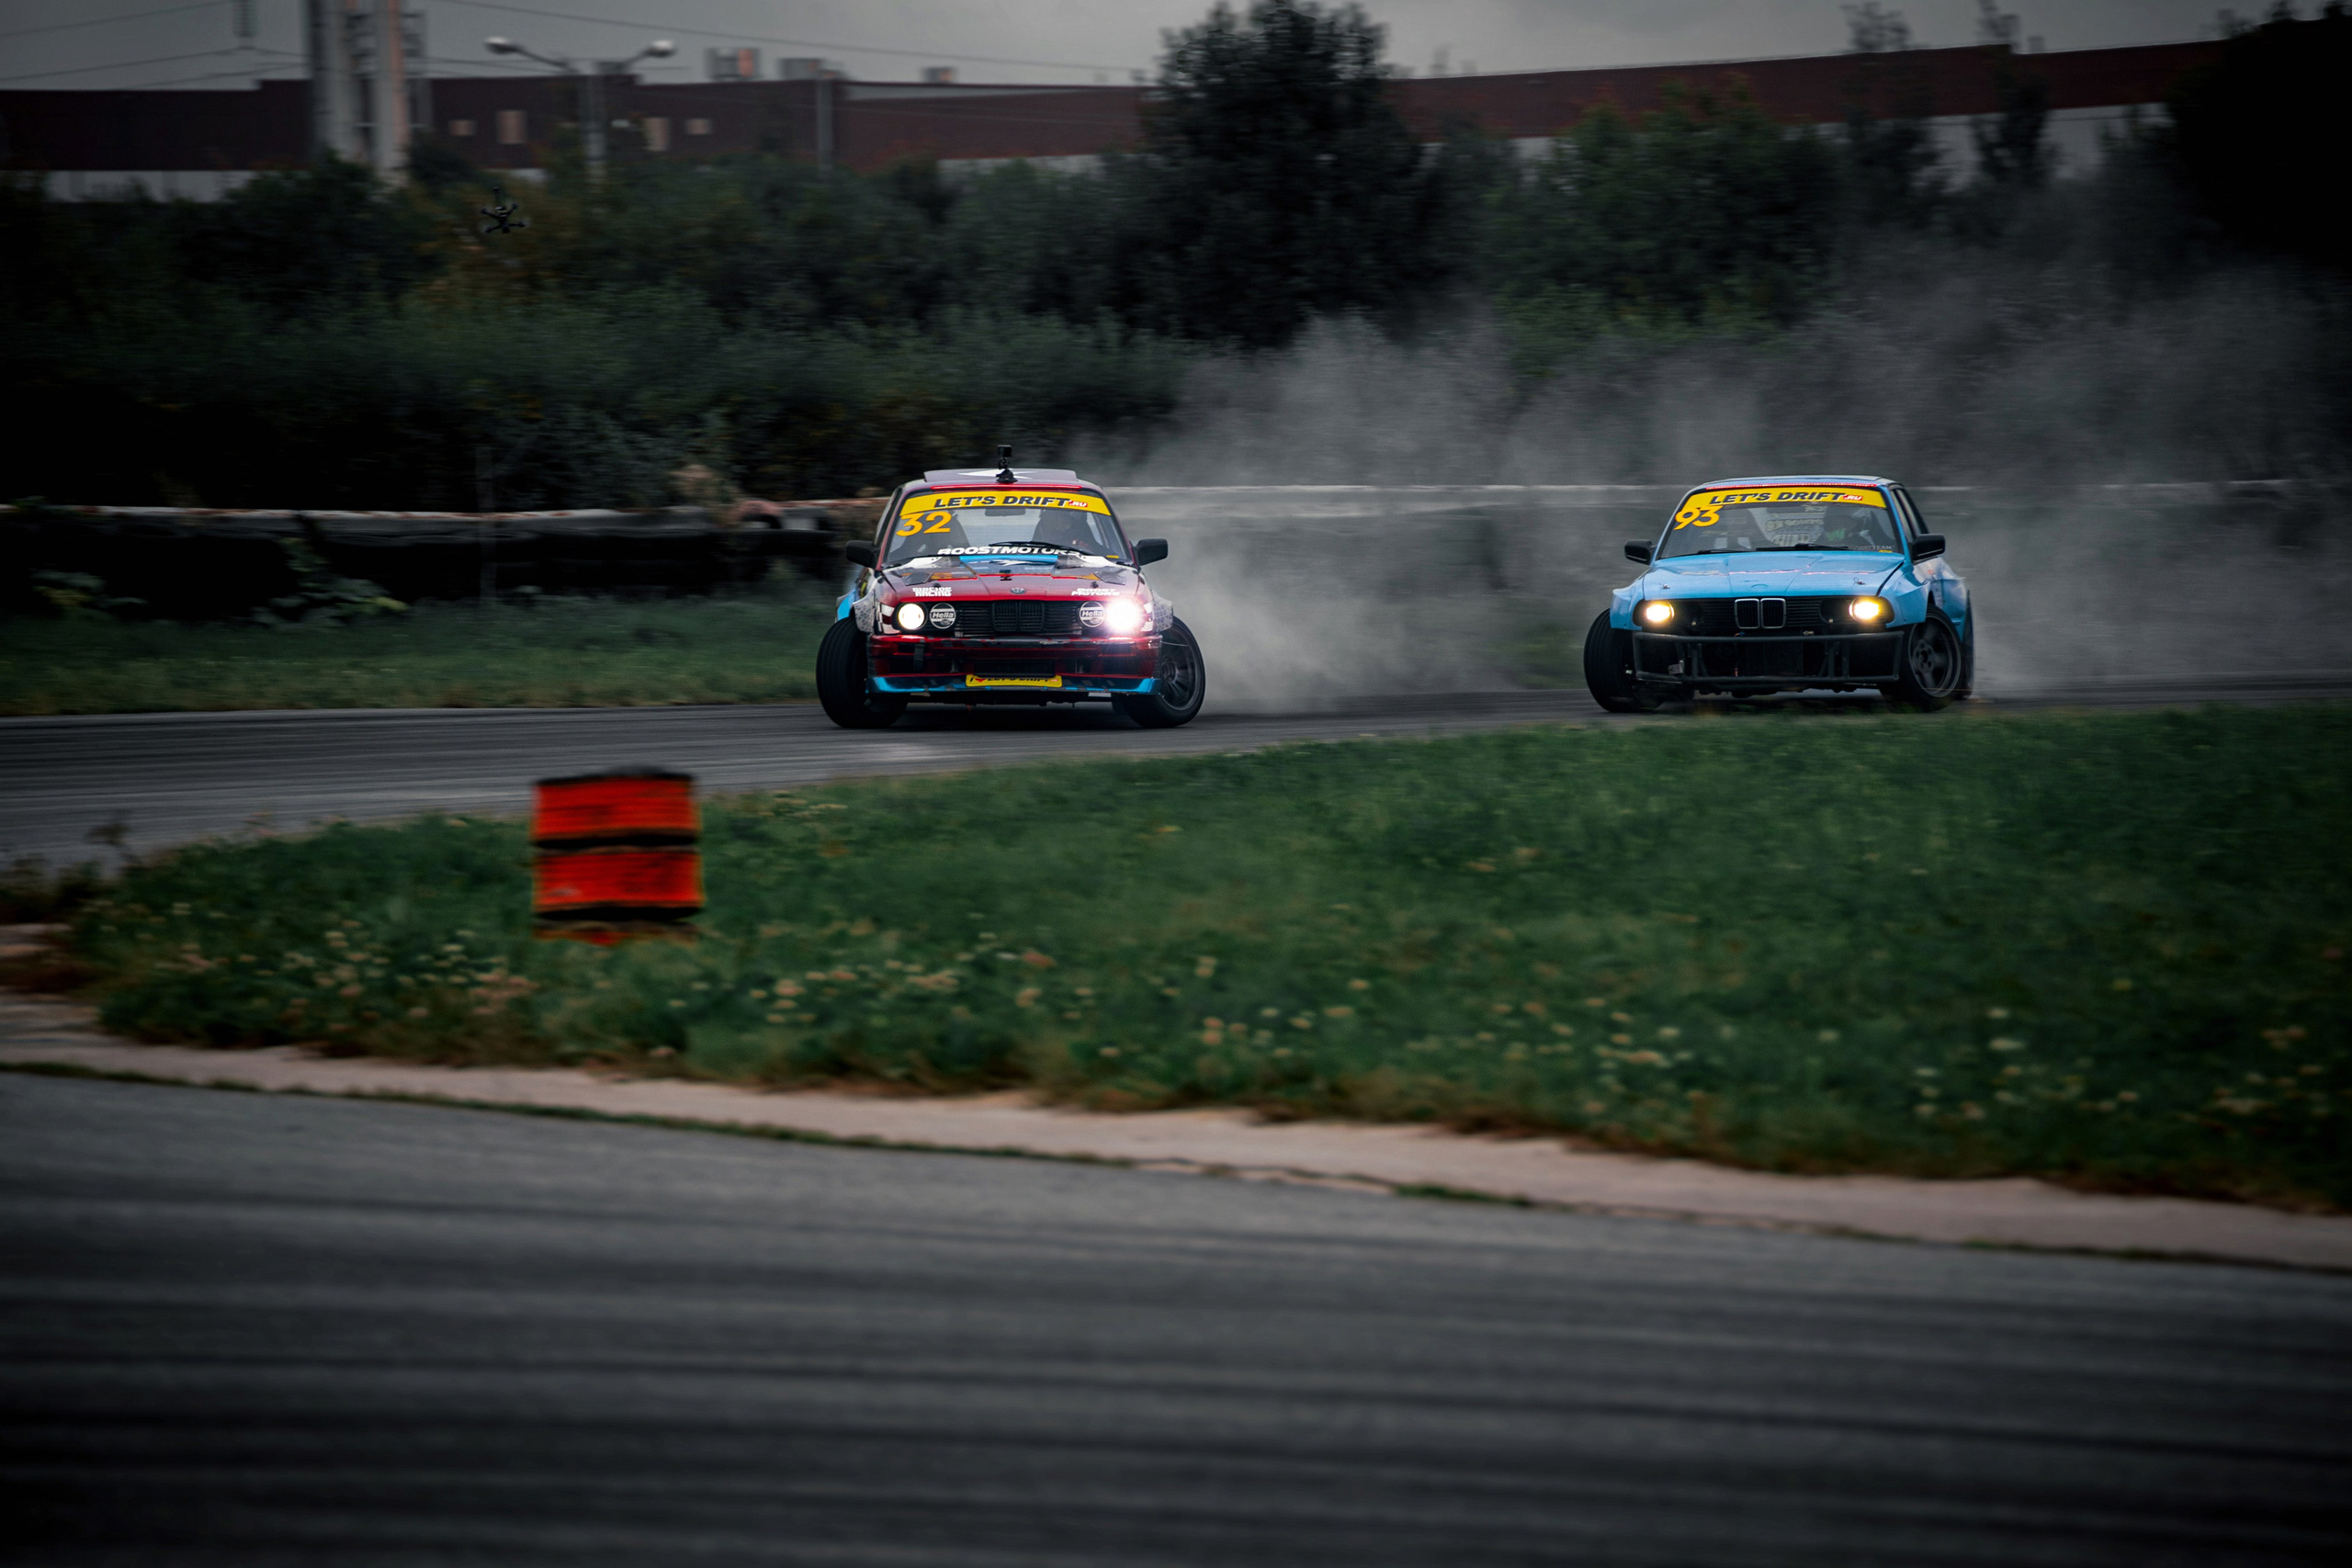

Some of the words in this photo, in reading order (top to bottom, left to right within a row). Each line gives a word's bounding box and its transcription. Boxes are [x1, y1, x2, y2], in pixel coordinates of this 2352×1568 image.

[933, 496, 997, 508] LET'S
[1709, 492, 1771, 504] LET'S
[896, 511, 952, 536] 32
[1673, 505, 1724, 530] 93
